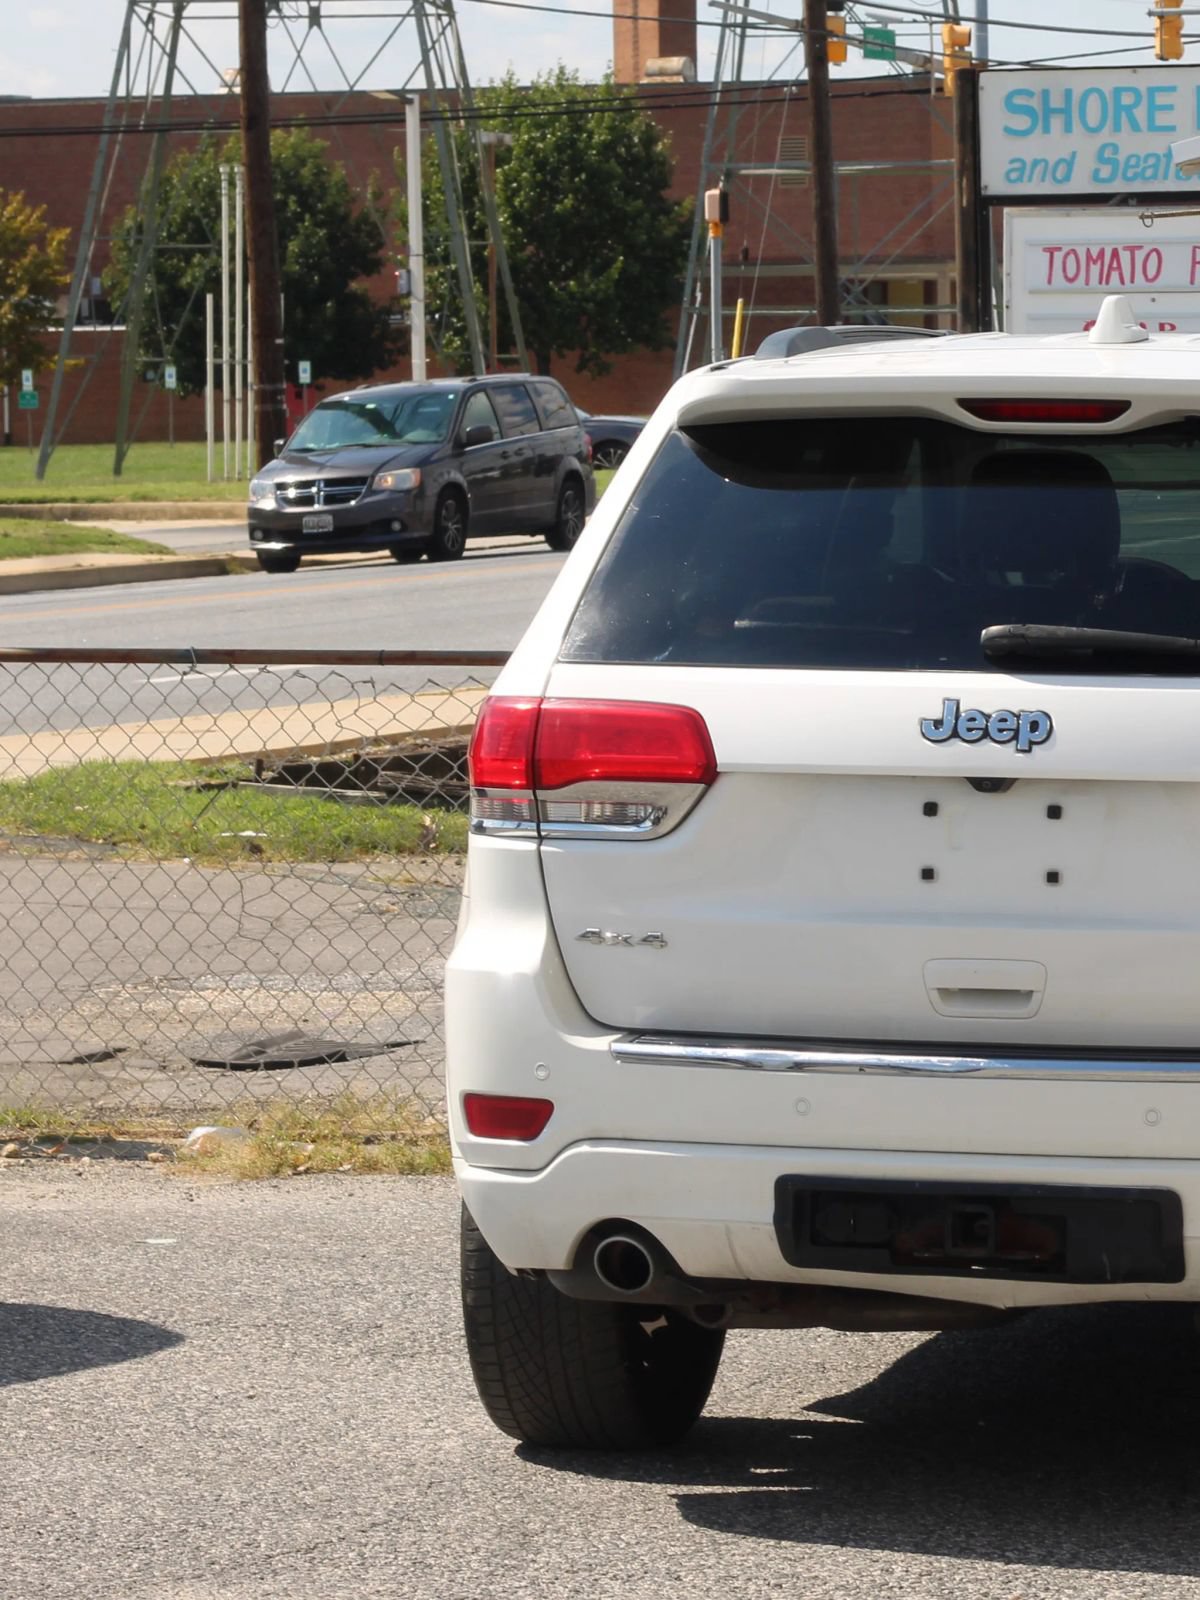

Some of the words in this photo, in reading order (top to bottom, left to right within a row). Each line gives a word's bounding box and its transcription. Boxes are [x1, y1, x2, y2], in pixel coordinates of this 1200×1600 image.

[1003, 84, 1178, 137] SHORE
[1005, 150, 1077, 185] and
[1042, 244, 1163, 286] TOMATO
[920, 697, 1054, 754] Jeep
